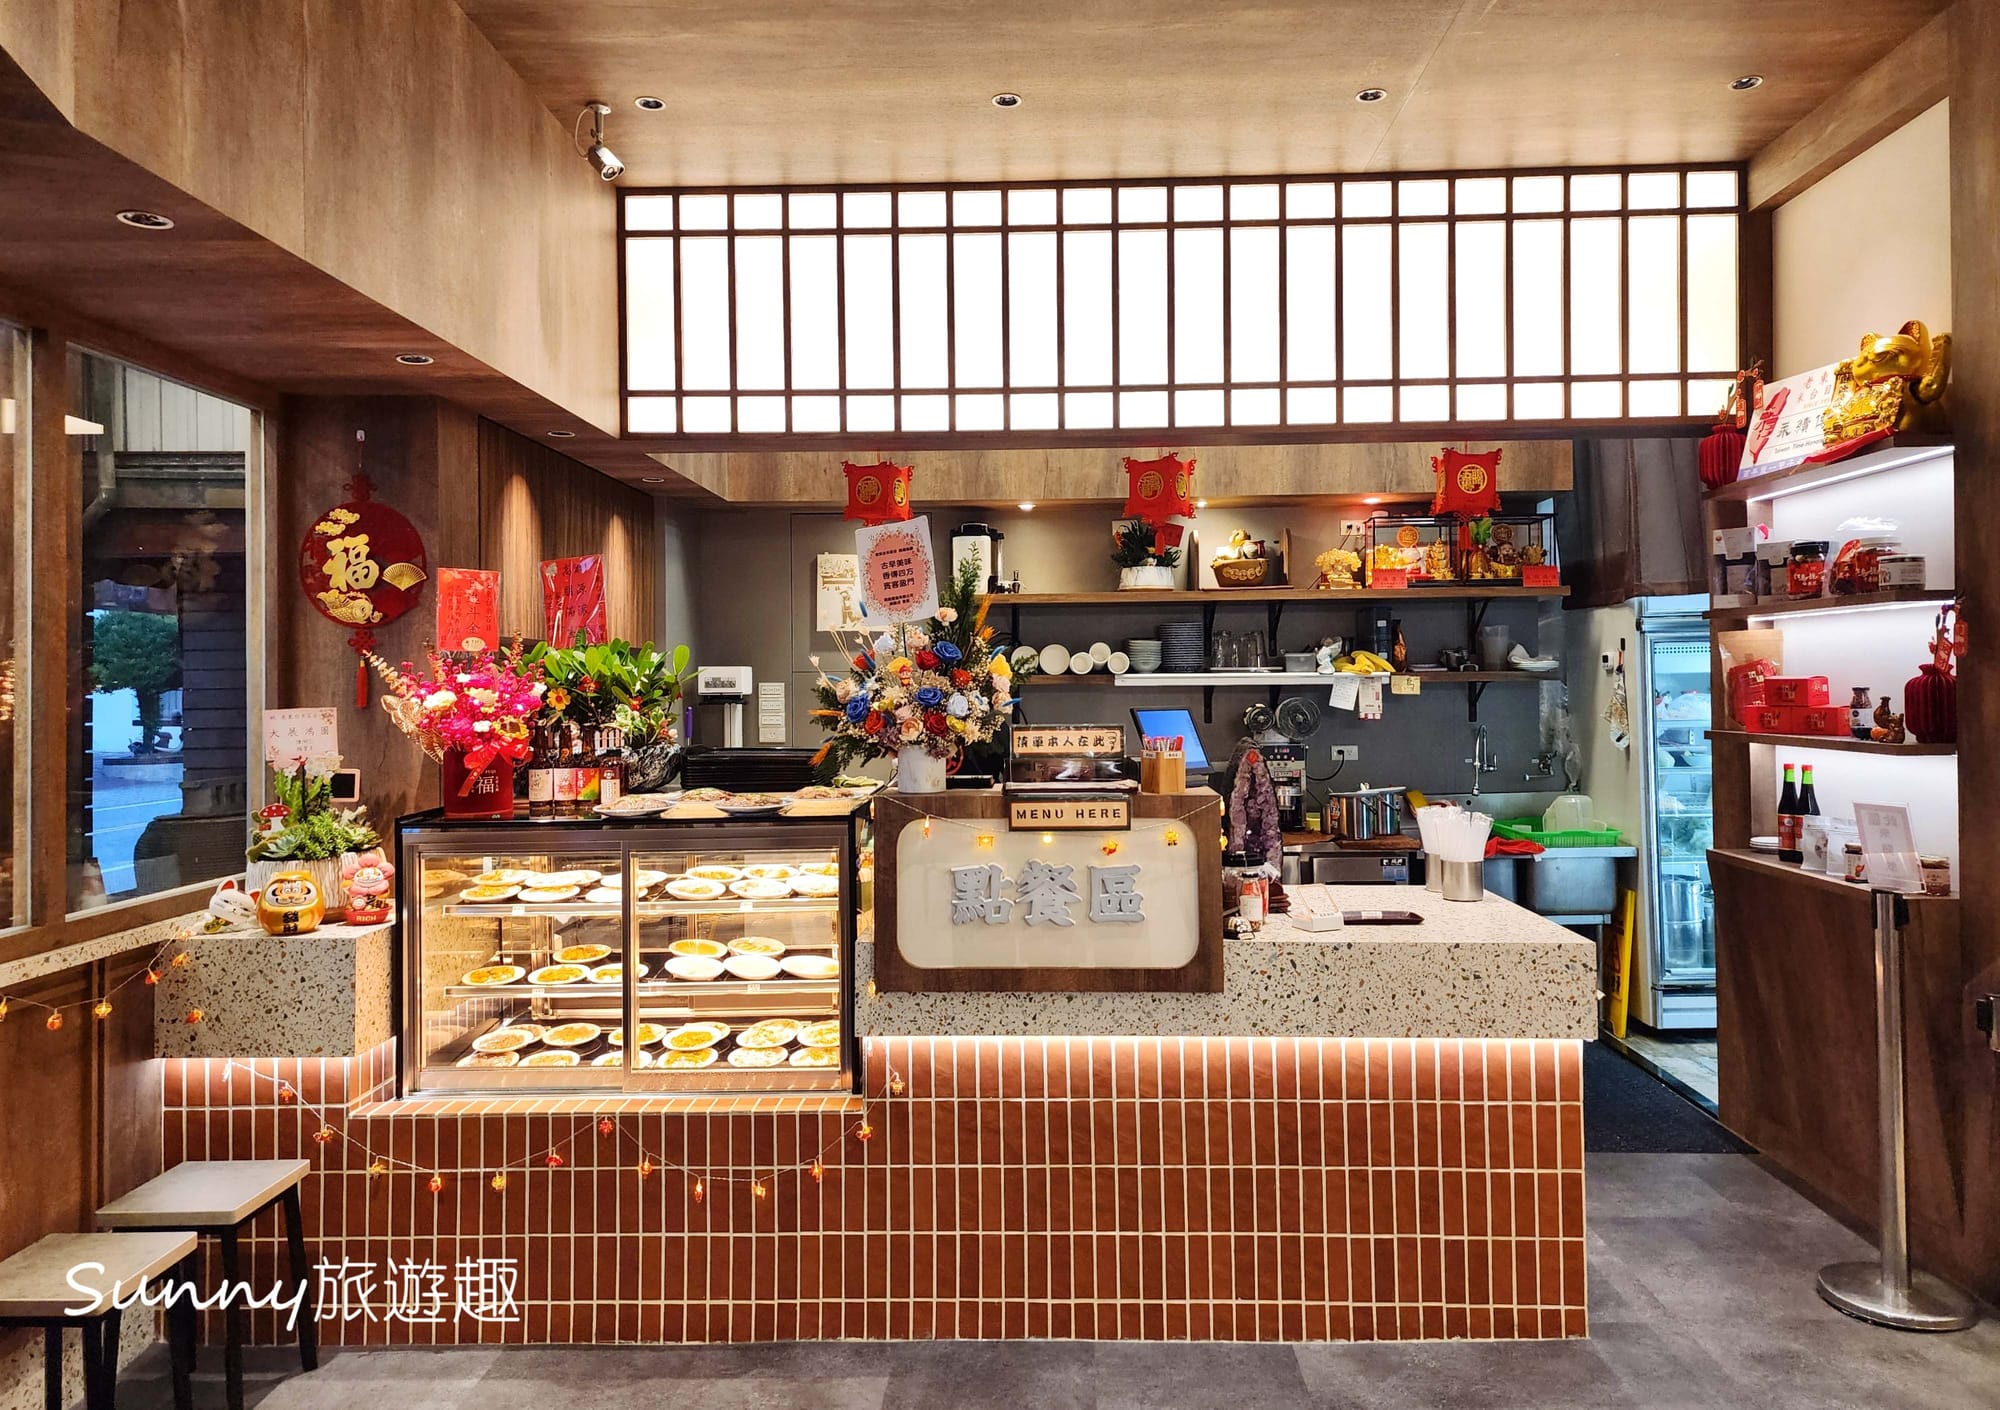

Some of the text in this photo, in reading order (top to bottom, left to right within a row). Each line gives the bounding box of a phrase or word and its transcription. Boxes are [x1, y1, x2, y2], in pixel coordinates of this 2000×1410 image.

[322, 533, 380, 593] 福
[880, 557, 913, 570] 古早美味
[882, 567, 914, 580] 香傳四方
[476, 775, 495, 795] 福
[1016, 808, 1121, 820] MENU HERE
[950, 858, 1146, 927] 點餐區
